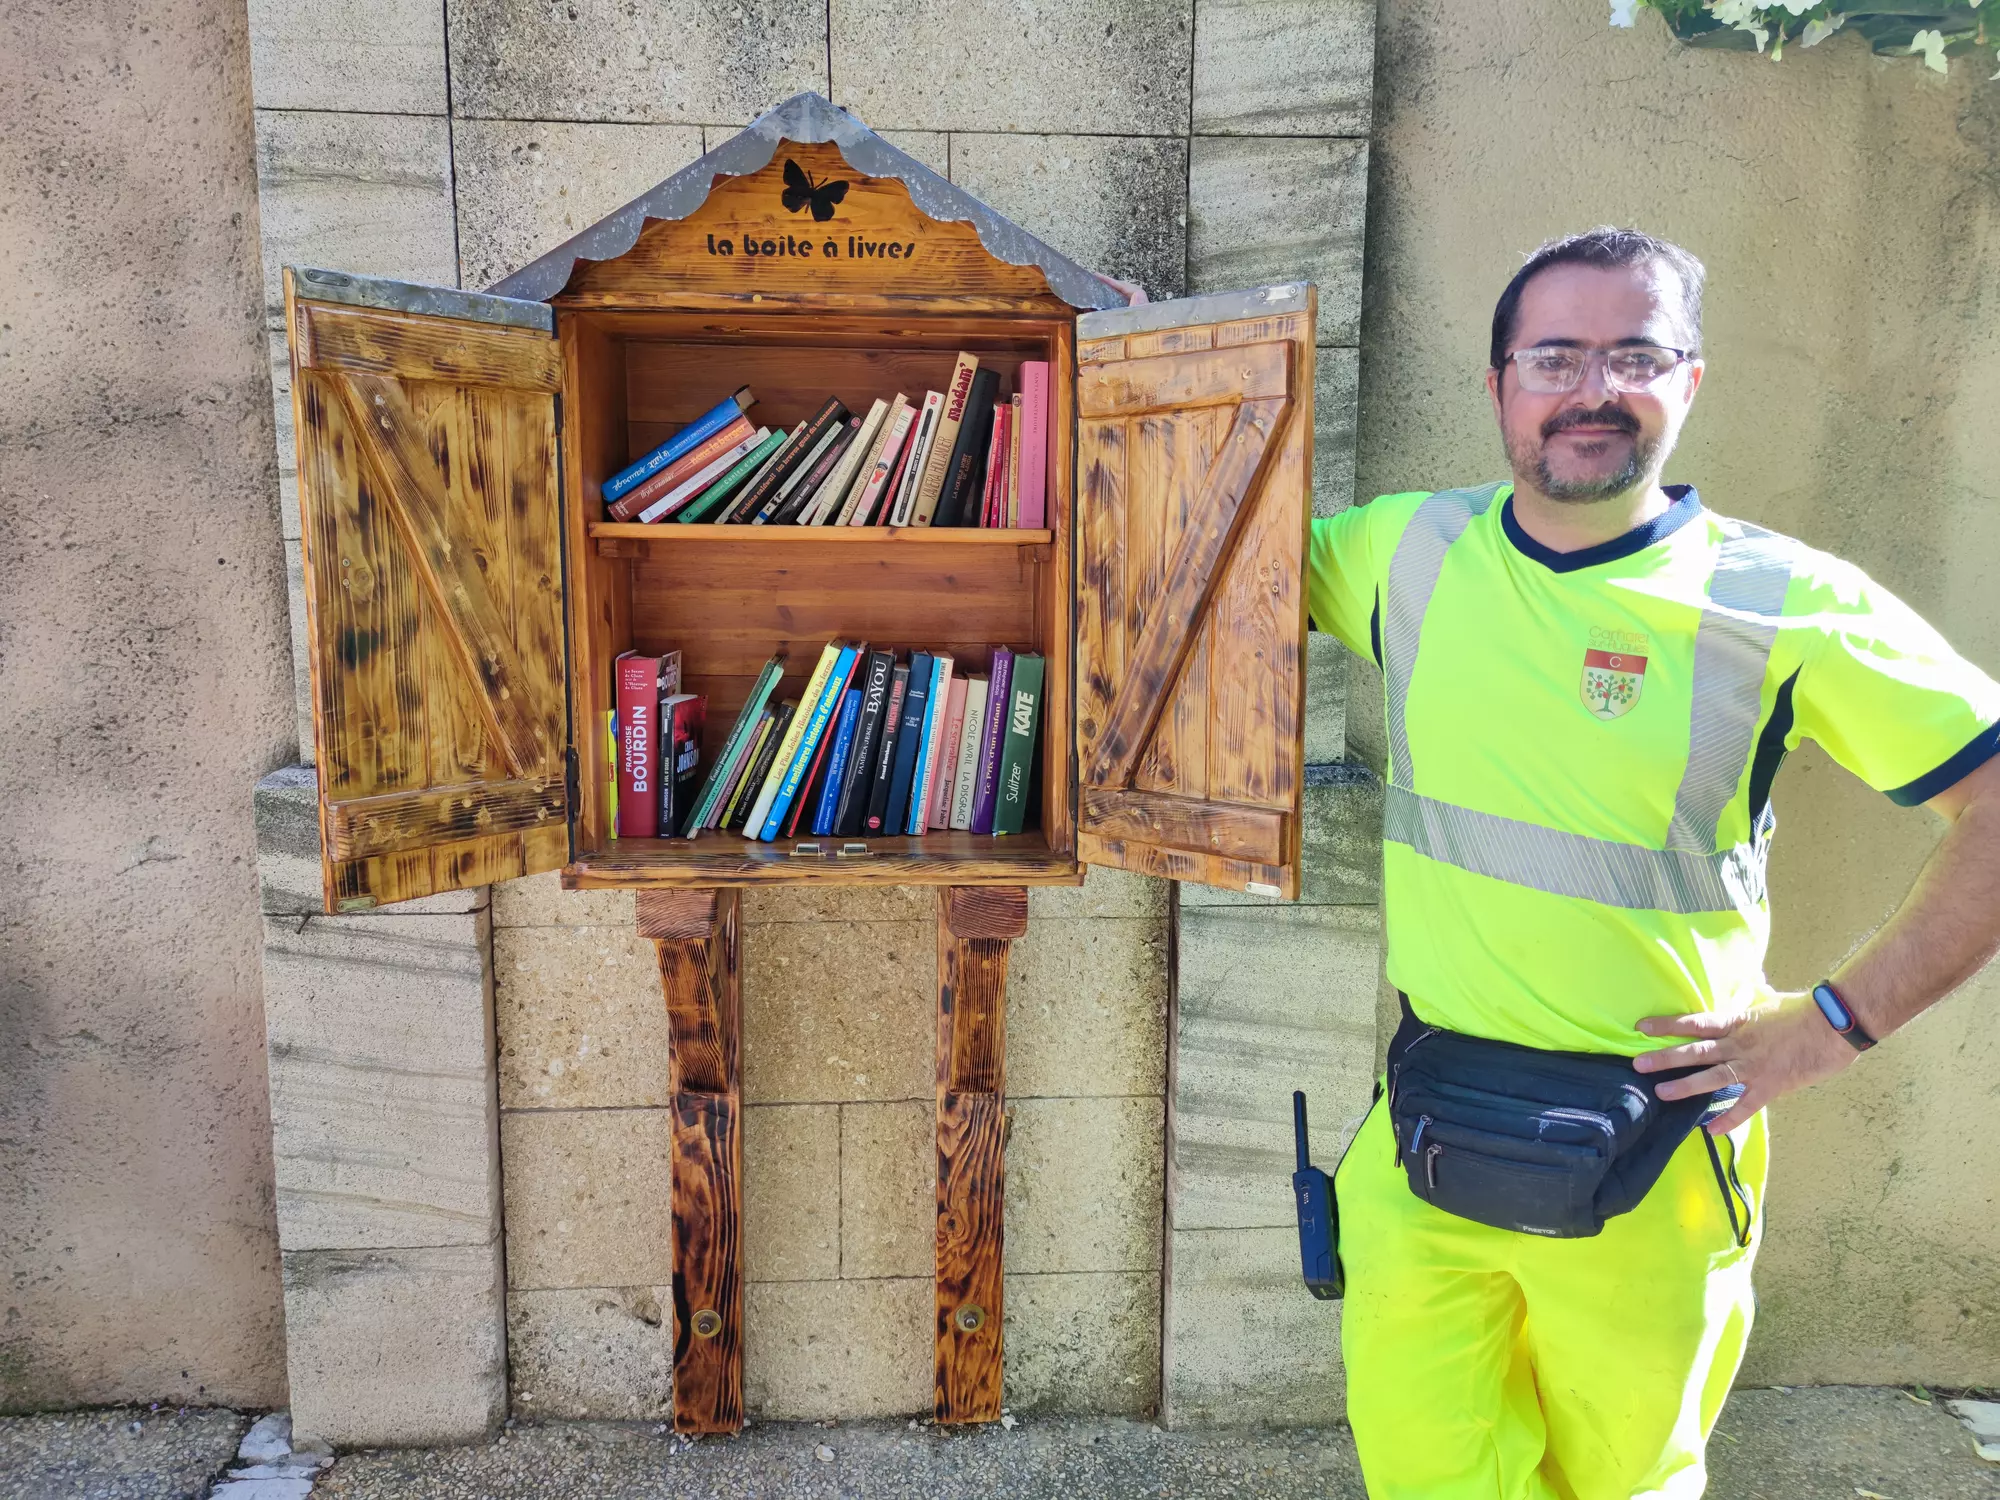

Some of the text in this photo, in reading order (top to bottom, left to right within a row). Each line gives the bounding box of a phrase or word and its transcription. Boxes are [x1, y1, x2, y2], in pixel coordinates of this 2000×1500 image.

[743, 234, 813, 257] boîte
[823, 236, 838, 258] à
[848, 235, 915, 259] livres
[717, 423, 747, 447] berger
[775, 462, 786, 473] les
[782, 445, 801, 465] braves
[798, 433, 812, 448] gens
[808, 424, 818, 435] du
[814, 399, 840, 428] tennessee
[875, 427, 889, 446] bière
[645, 451, 665, 470] petit
[871, 446, 880, 456] de
[611, 463, 648, 492] sauvage
[860, 454, 877, 480] gorgée
[922, 435, 953, 501] XAVIERA HOLLANDER
[738, 493, 759, 515] erskine
[755, 472, 777, 496] caldwell
[845, 479, 865, 509] première
[952, 490, 958, 499] LA
[842, 508, 850, 518] La
[1610, 656, 1622, 668] C
[866, 660, 889, 715] BAYOU
[773, 660, 833, 780] Les Plus Jolies Histoires de la ferme
[888, 703, 899, 727] MACHINE
[951, 716, 962, 730] Le
[1011, 690, 1035, 737] KATE
[633, 706, 647, 792] BOURDIN
[781, 783, 795, 799] Les
[788, 745, 812, 785] meilleures
[805, 714, 826, 747] histoires
[818, 675, 843, 715] d'animaux
[858, 721, 874, 775] PAMELA JEKEL
[985, 702, 1001, 795] Le Prix d'un Enfant
[879, 767, 887, 780] Arnaud
[957, 709, 978, 824] NICOLE AVRIL LA DISGRACE
[941, 779, 951, 808] Jacqueline
[1007, 762, 1023, 804] Sulitzer
[939, 809, 947, 826] Fabre
